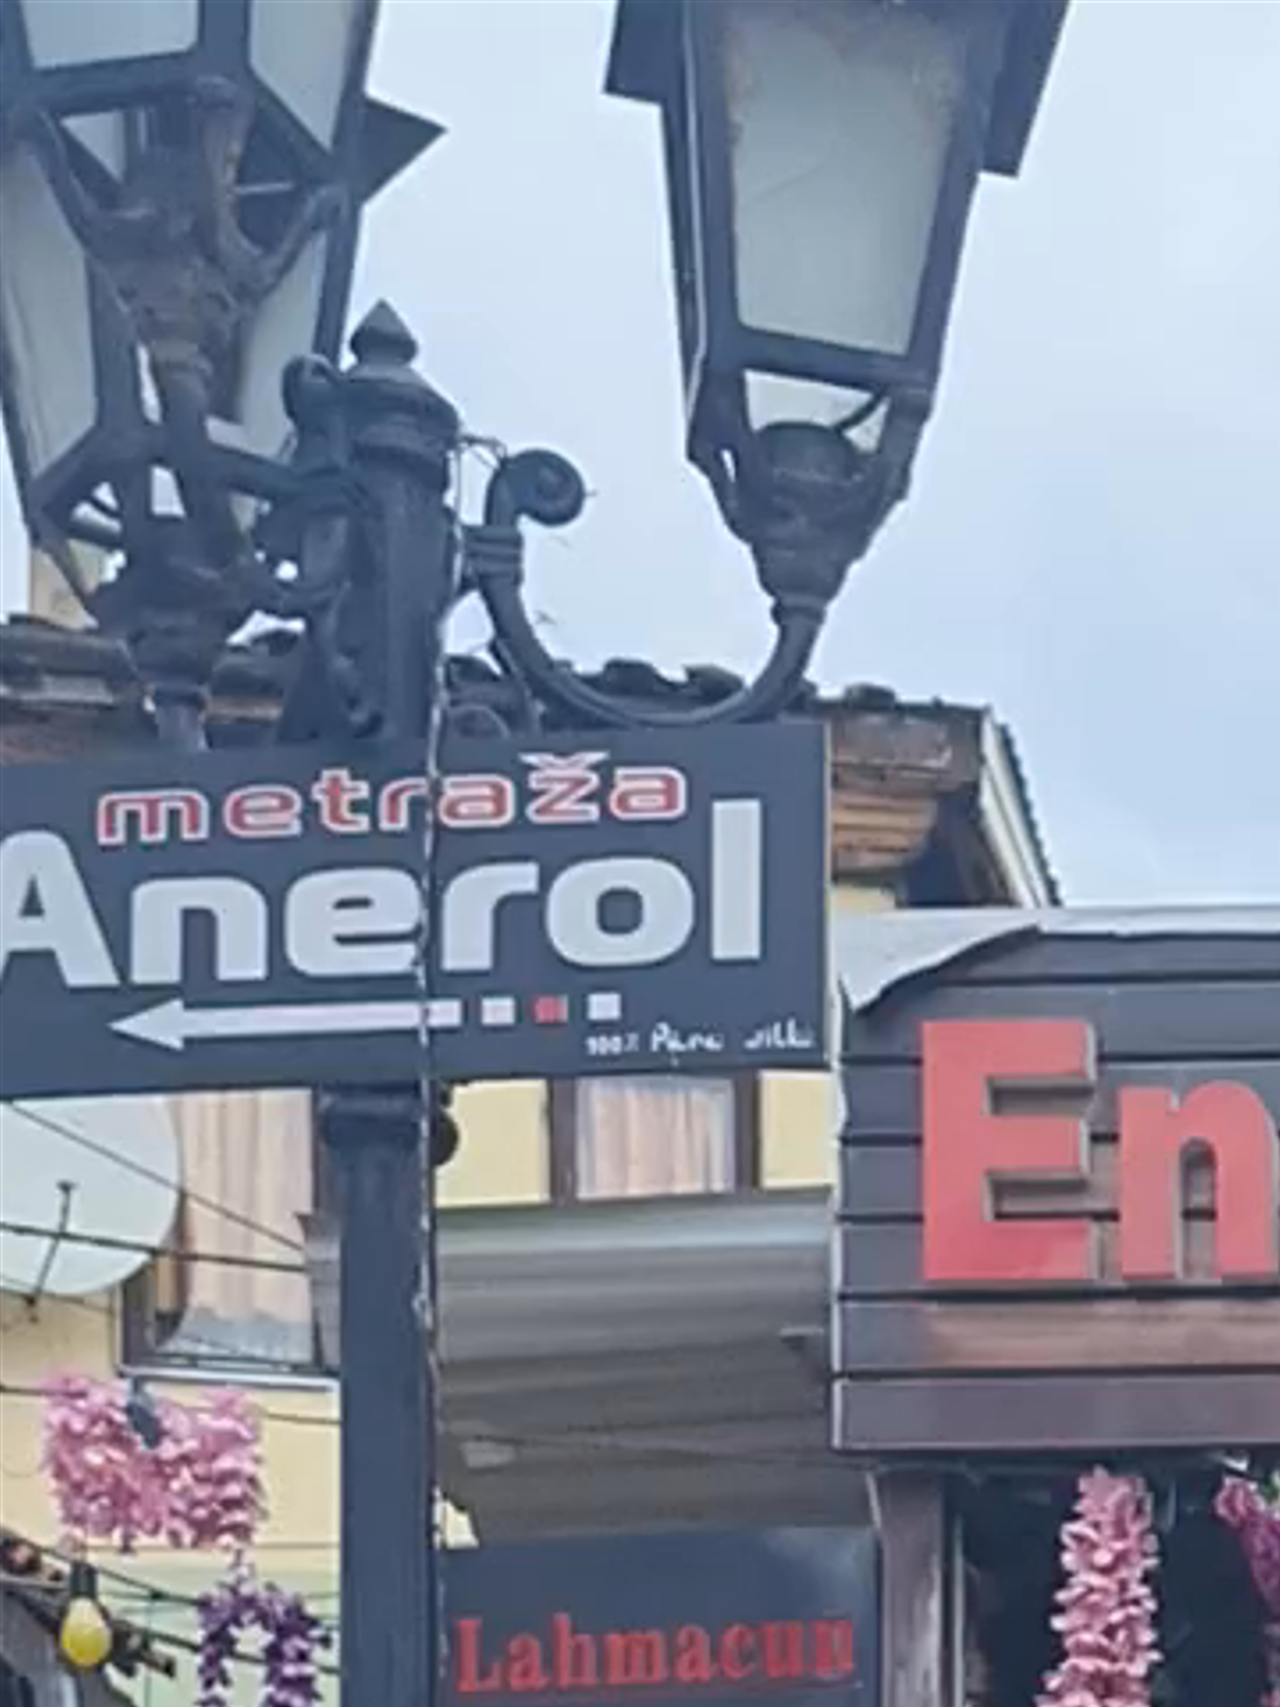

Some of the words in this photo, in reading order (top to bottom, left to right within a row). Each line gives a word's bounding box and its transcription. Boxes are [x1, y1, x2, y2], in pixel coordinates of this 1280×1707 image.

[97, 751, 687, 846] metraža
[0, 800, 763, 987] Anerol
[453, 1614, 855, 1694] Lahmacun
